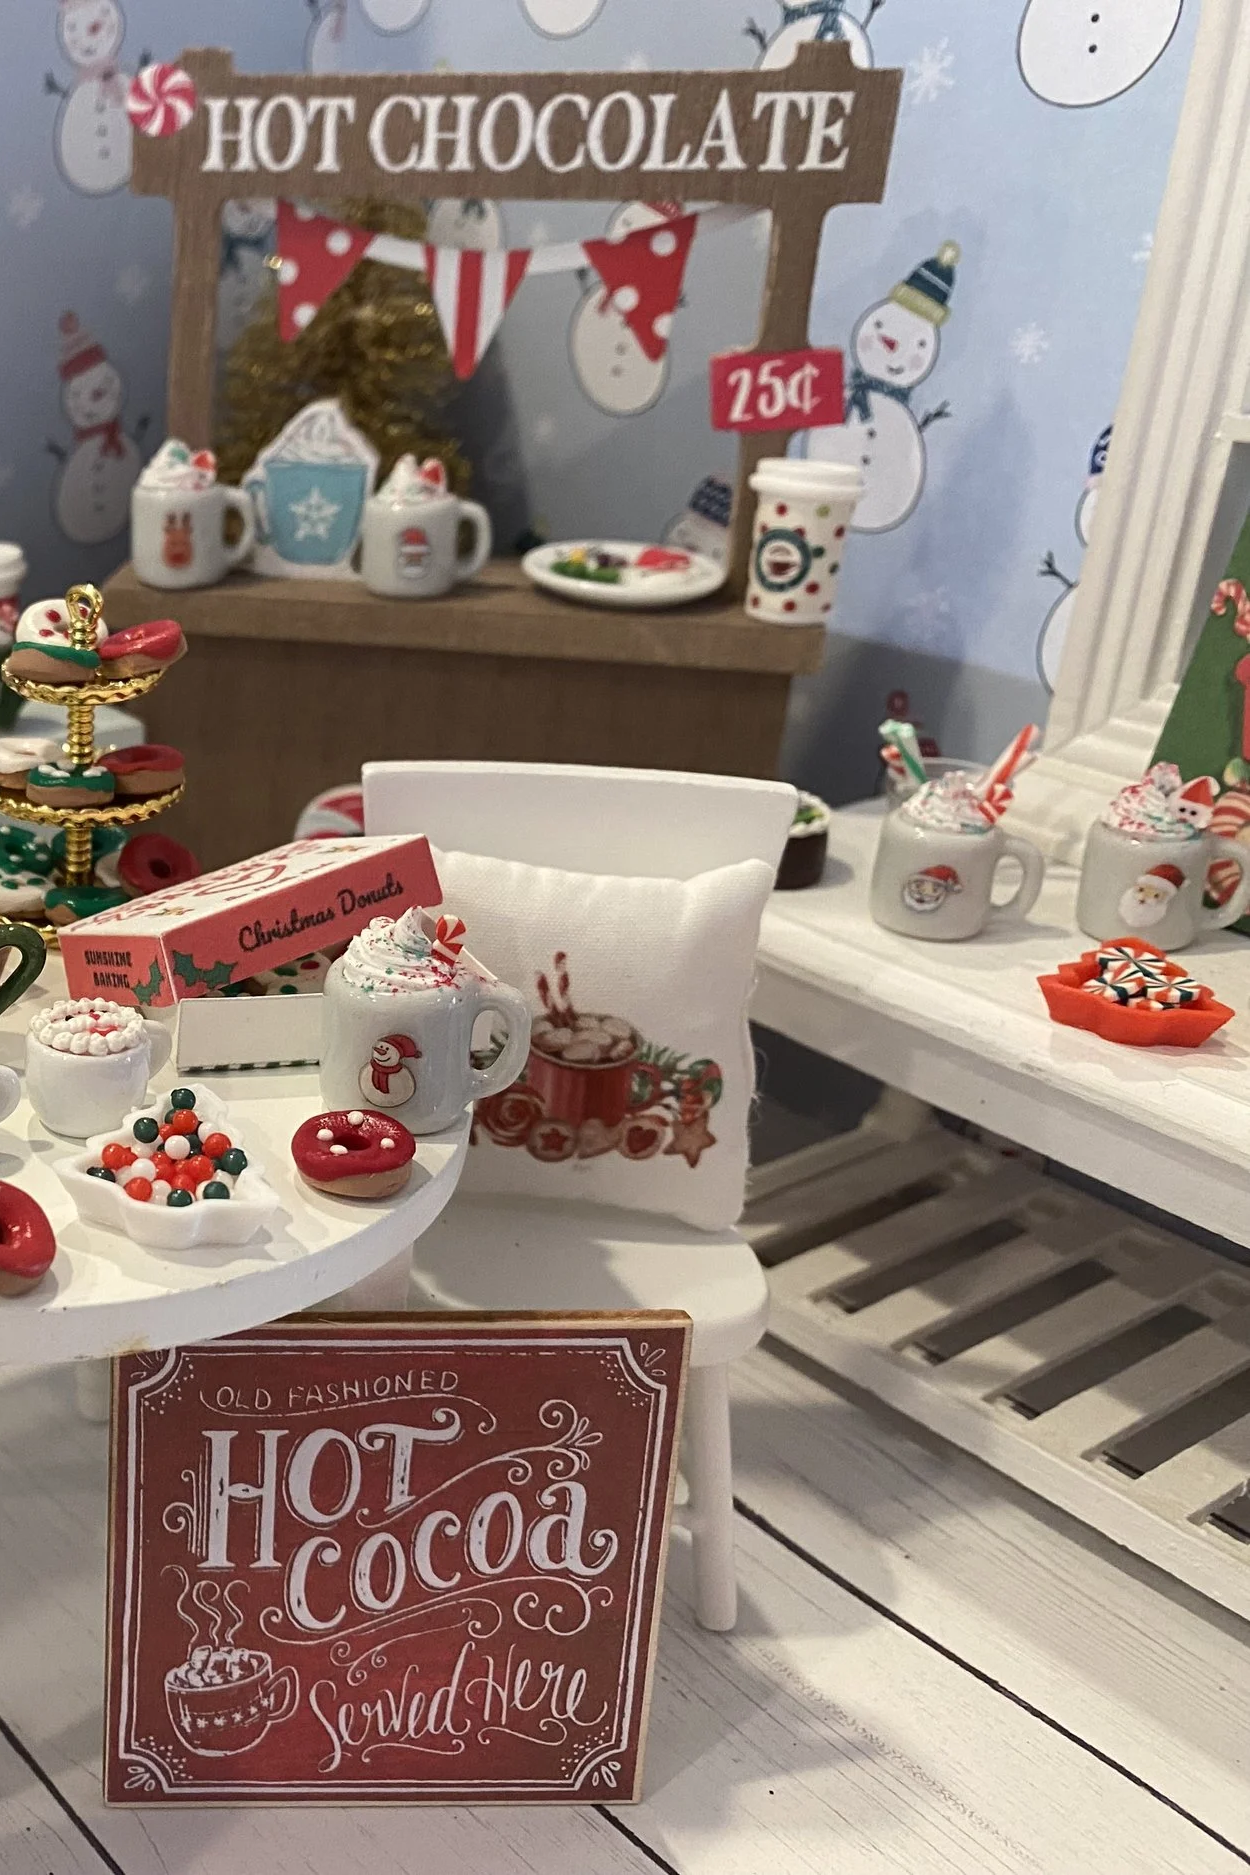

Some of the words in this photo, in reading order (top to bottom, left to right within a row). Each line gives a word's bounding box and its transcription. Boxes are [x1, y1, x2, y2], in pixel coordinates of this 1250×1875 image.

[201, 95, 356, 173] HOT
[368, 88, 856, 173] CHOCOLATE
[726, 358, 822, 423] 25¢
[238, 907, 336, 953] Christmas
[336, 872, 404, 916] Donuts
[84, 950, 133, 968] SUNSHINE
[93, 971, 131, 989] BAKING
[216, 1386, 272, 1411] OLD
[289, 1370, 459, 1408] FASHIONED
[196, 1406, 464, 1572] HOT
[309, 1640, 472, 1774] Served
[464, 1643, 609, 1726] Here
